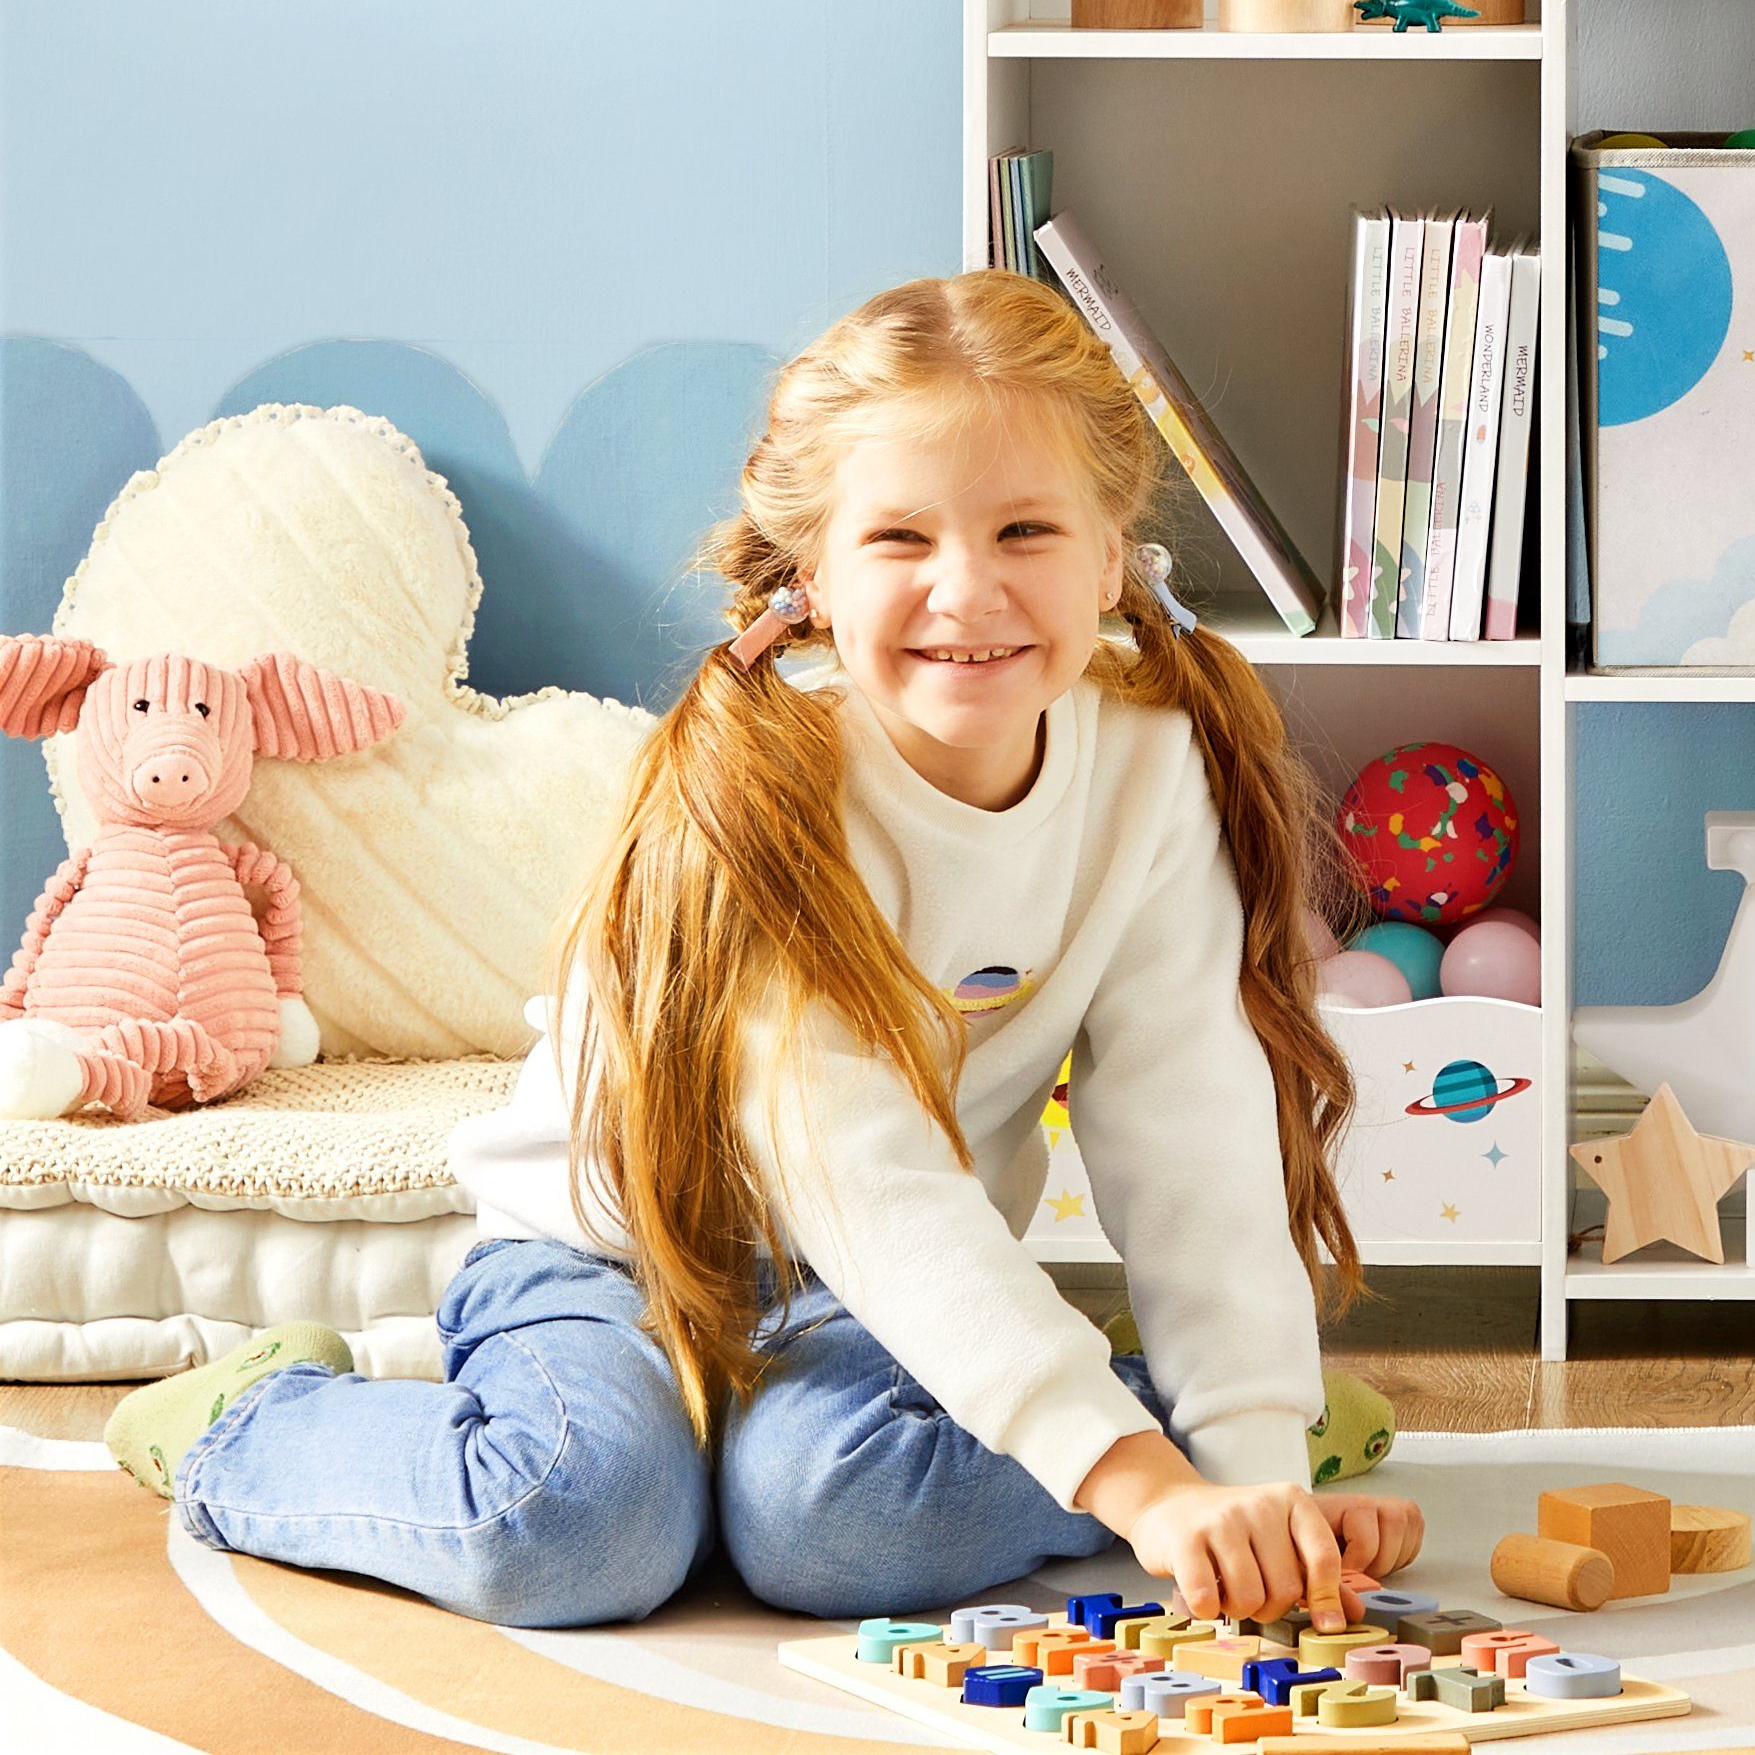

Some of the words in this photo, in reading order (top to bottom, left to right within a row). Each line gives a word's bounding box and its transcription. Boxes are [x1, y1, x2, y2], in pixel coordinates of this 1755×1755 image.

[1066, 267, 1112, 330] MERMAID
[1371, 246, 1383, 297] LITTLE
[1402, 247, 1415, 297] LITTLE
[1427, 248, 1441, 299] LITTLE
[1396, 307, 1412, 382] BALLERINA
[1478, 324, 1494, 413] WONDERLAND
[1512, 345, 1528, 417] MERMAID
